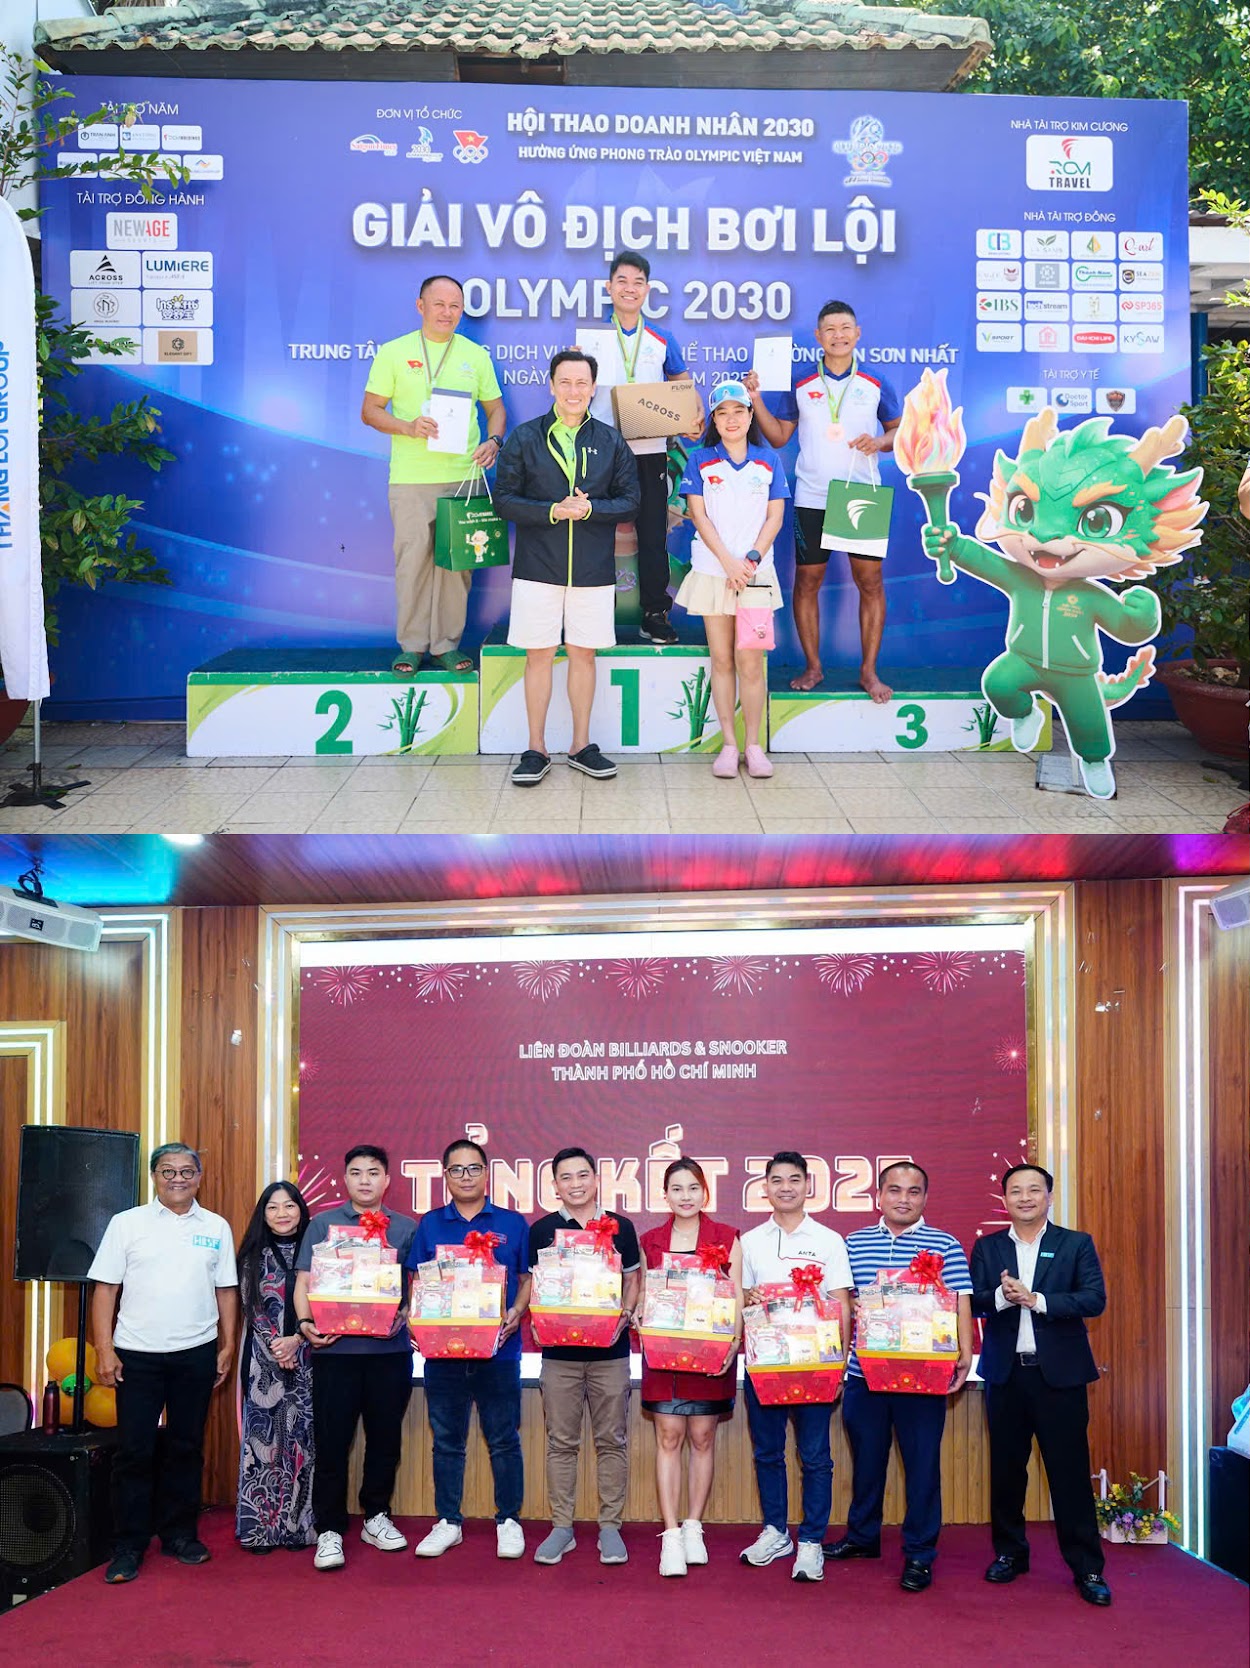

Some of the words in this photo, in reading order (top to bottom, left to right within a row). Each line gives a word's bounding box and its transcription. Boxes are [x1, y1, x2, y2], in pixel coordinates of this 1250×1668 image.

[148, 102, 179, 115] NĂM
[376, 108, 400, 119] ĐƠN
[403, 109, 414, 121] VỊ
[416, 105, 430, 119] TỔ
[432, 108, 462, 119] CHỨC
[507, 107, 545, 137] HỘI
[550, 112, 609, 133] THAO
[615, 114, 690, 135] DOANH
[696, 111, 758, 136] NHÂN
[763, 117, 814, 137] 2030
[1010, 119, 1033, 131] NHÀ
[1033, 119, 1049, 131] TÀI
[1049, 121, 1070, 133] TRỢ
[1071, 121, 1088, 131] KIM
[1091, 121, 1128, 132] CƯƠNG
[569, 143, 597, 160] ỨNG
[600, 148, 645, 160] PHONG
[648, 145, 682, 161] TRÀO
[685, 148, 740, 162] OLYMPIC
[742, 147, 771, 165] VIỆT
[773, 150, 802, 163] NAM
[1049, 177, 1091, 189] TRAVEL
[76, 192, 95, 204] TÀI
[97, 192, 122, 206] TRỢ
[169, 192, 205, 206] HÀNH
[1024, 210, 1046, 222] NHÀ
[1047, 210, 1063, 222] TÀI
[1063, 211, 1083, 223] TRỢ
[1084, 210, 1116, 223] ĐỒNG
[113, 219, 170, 237] NEWAGE
[352, 187, 464, 248] GIẢI
[475, 189, 547, 249] VÔ
[562, 204, 690, 262] ĐỊCH
[707, 206, 797, 252] BƠI
[813, 194, 896, 265] LỘI
[463, 277, 669, 320] OLYMPC
[682, 281, 791, 320] 2030
[994, 298, 1019, 312] IBS
[288, 343, 351, 360] TRUNG
[355, 340, 381, 360] TÂ
[496, 344, 538, 363] DỊCH
[702, 346, 748, 362] THAO
[869, 347, 906, 364] SƠN
[911, 343, 959, 364] NHẤT
[503, 366, 549, 385] NGÀY
[1043, 369, 1057, 379] TÀI
[1060, 369, 1078, 381] TRỢ
[1079, 370, 1087, 379] Y
[1089, 367, 1101, 379] TẾ
[637, 397, 682, 422] ACROSS
[1070, 399, 1088, 407] Sport
[315, 690, 353, 755] 2
[610, 668, 640, 747] 1
[895, 704, 929, 749] 3
[519, 1040, 554, 1059] LIÊN
[558, 1040, 605, 1058] ĐOÀN
[608, 1041, 692, 1058] BILLIARDS
[694, 1041, 706, 1056] &
[709, 1039, 788, 1055] SNOOKER
[552, 1063, 608, 1081] THÀNH
[612, 1059, 647, 1080] PHỐ
[651, 1058, 675, 1080] HỒ
[679, 1061, 709, 1079] CHÍ
[712, 1063, 757, 1079] MINH
